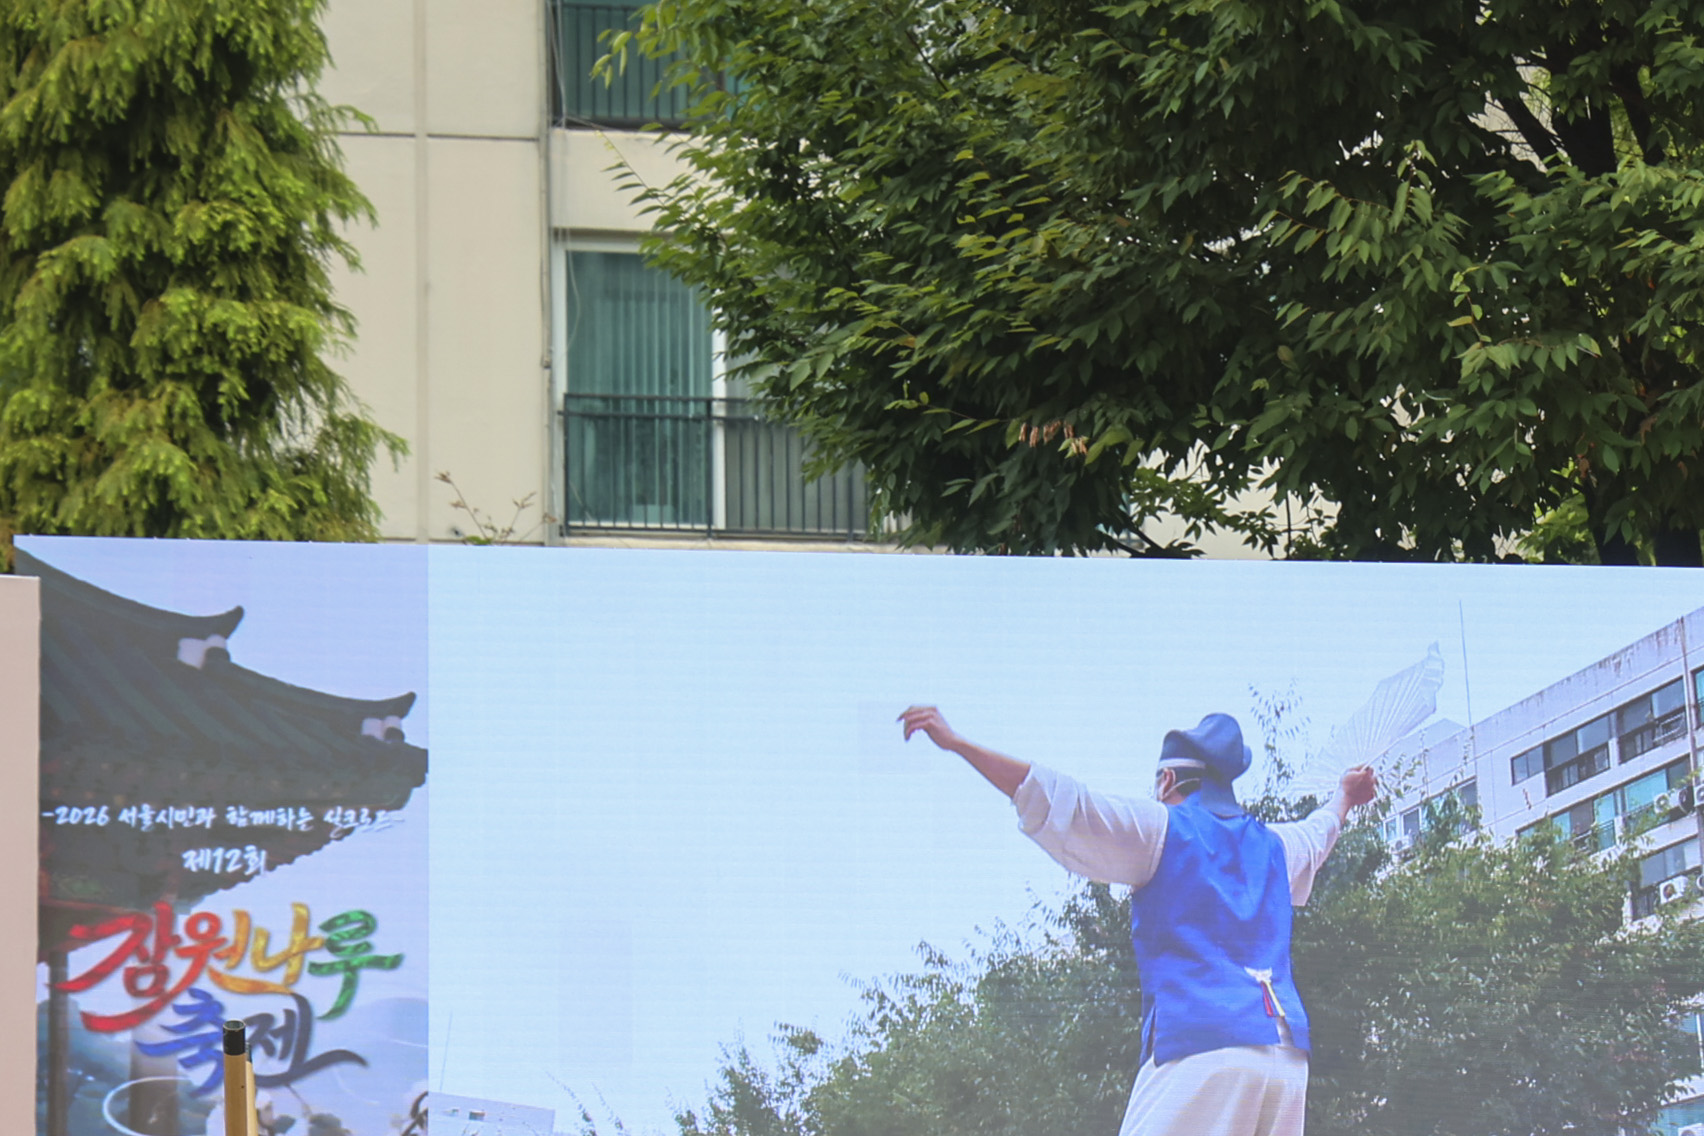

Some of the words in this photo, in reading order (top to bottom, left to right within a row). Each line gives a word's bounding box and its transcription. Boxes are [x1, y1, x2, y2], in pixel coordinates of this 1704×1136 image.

[41, 806, 109, 826] -2026
[118, 804, 217, 831] 서울시민과
[226, 805, 314, 831] 함께하는
[182, 845, 268, 875] 제12회
[53, 901, 405, 1035] 잠원나루
[136, 987, 370, 1096] 축제
